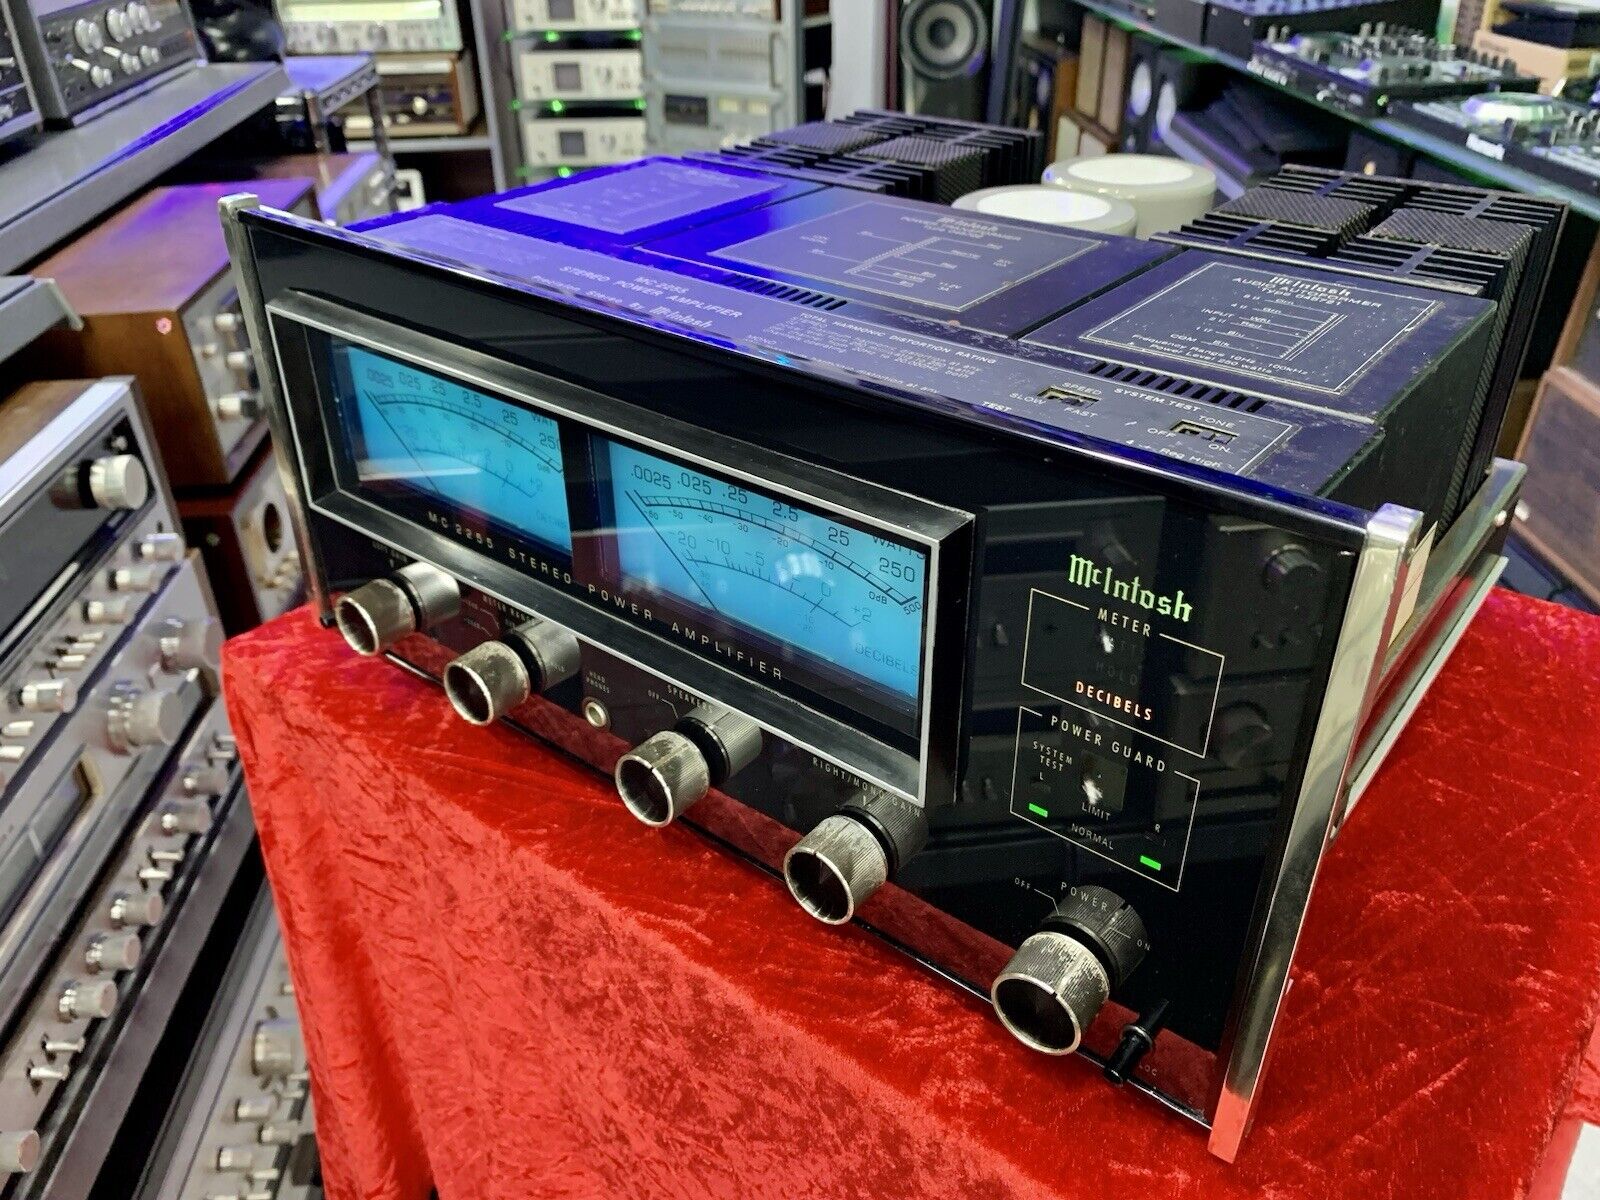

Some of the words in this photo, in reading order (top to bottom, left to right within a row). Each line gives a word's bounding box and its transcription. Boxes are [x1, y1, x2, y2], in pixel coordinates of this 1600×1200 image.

[1232, 276, 1276, 291] AUDIO
[1269, 276, 1352, 298] McIntosh
[665, 294, 743, 319] AMPLIFIER
[1201, 307, 1235, 318] INPUT
[832, 320, 886, 338] HARMONIC
[889, 334, 952, 354] DISTORTION
[954, 350, 998, 365] RATING
[1131, 334, 1187, 350] Frequency
[1189, 345, 1226, 358] Range
[1170, 333, 1198, 343] COM
[1150, 343, 1184, 356] Power
[1186, 352, 1217, 363] Level
[1009, 391, 1048, 406] SLOW
[1061, 381, 1103, 396] SPEED
[982, 400, 1013, 414] TEST
[1114, 387, 1166, 406] SYSTEM
[1168, 399, 1202, 413] TEST
[502, 408, 520, 427] 25
[1063, 406, 1099, 419] FAST
[1198, 415, 1236, 429] TONE
[1147, 426, 1177, 439] OFF
[1208, 443, 1231, 454] ON
[630, 464, 672, 490] .0025
[677, 472, 712, 496] .025
[722, 484, 748, 505] .25
[772, 501, 799, 523] 2.5
[828, 526, 850, 547] 25
[668, 530, 697, 550] -20
[707, 537, 731, 556] -10
[879, 556, 916, 583] 250
[427, 510, 449, 529] MC
[508, 547, 572, 585] STEREO
[588, 583, 653, 621] POWER
[671, 621, 783, 681] AMPLIFIER
[821, 581, 832, 598] 0
[868, 590, 888, 605] 0dB
[1068, 553, 1194, 623] McIntosh
[902, 601, 923, 616] 500
[1097, 607, 1151, 637] METER
[855, 642, 918, 676] DECIBELS
[666, 684, 714, 715] SPEAKERS
[1075, 680, 1152, 721] DECIBELS
[1032, 740, 1074, 766] SYSTEM
[1051, 714, 1102, 747] POWER
[1111, 741, 1166, 773] GUARD
[1039, 754, 1064, 773] TEST
[812, 756, 885, 800] RIGHT/MONO
[892, 797, 923, 818] GAIN
[1081, 801, 1112, 821] LIMIT
[1071, 822, 1115, 851] NORMAL
[1154, 823, 1161, 834] R
[1014, 877, 1032, 891] OFF
[1060, 881, 1108, 913] POWER
[1136, 938, 1152, 951] ON
